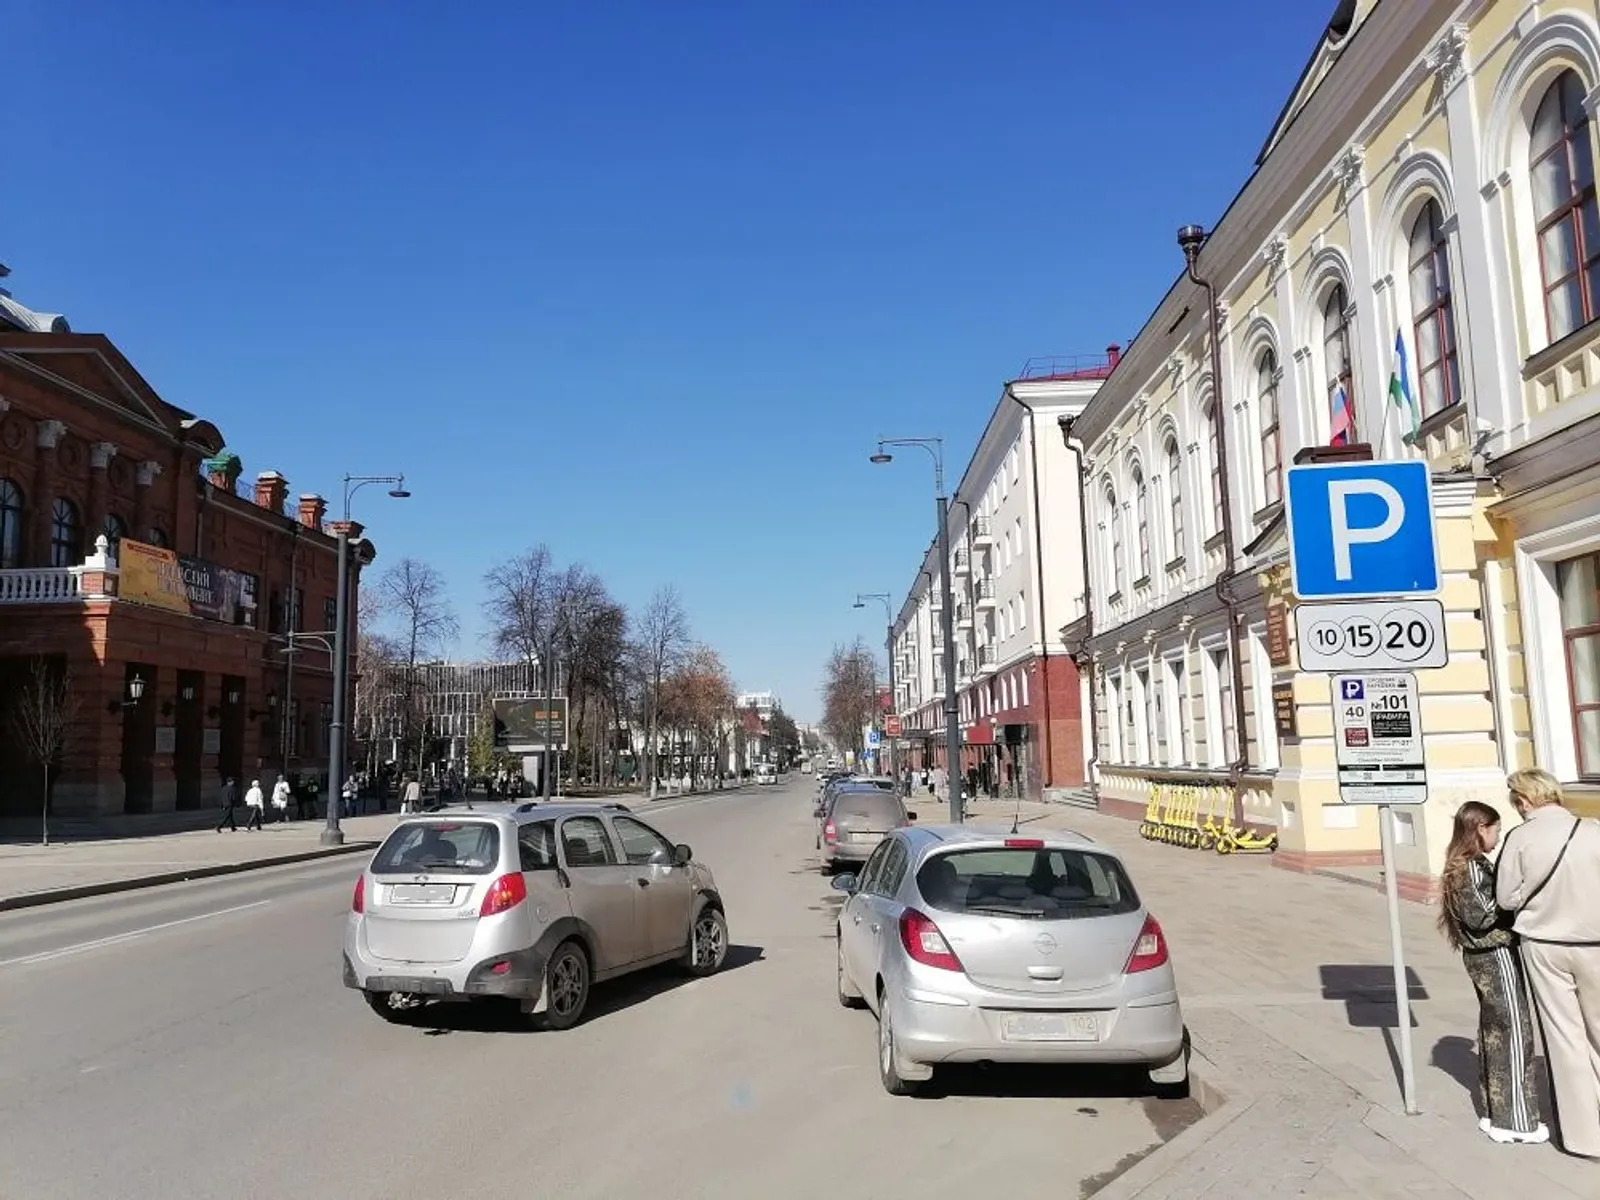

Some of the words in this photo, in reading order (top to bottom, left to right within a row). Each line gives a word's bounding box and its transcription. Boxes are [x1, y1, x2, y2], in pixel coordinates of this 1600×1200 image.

[1328, 479, 1405, 581] P
[1316, 629, 1337, 645] 10
[1346, 625, 1374, 647] 15
[1385, 620, 1427, 649] 20
[1345, 706, 1365, 717] 40
